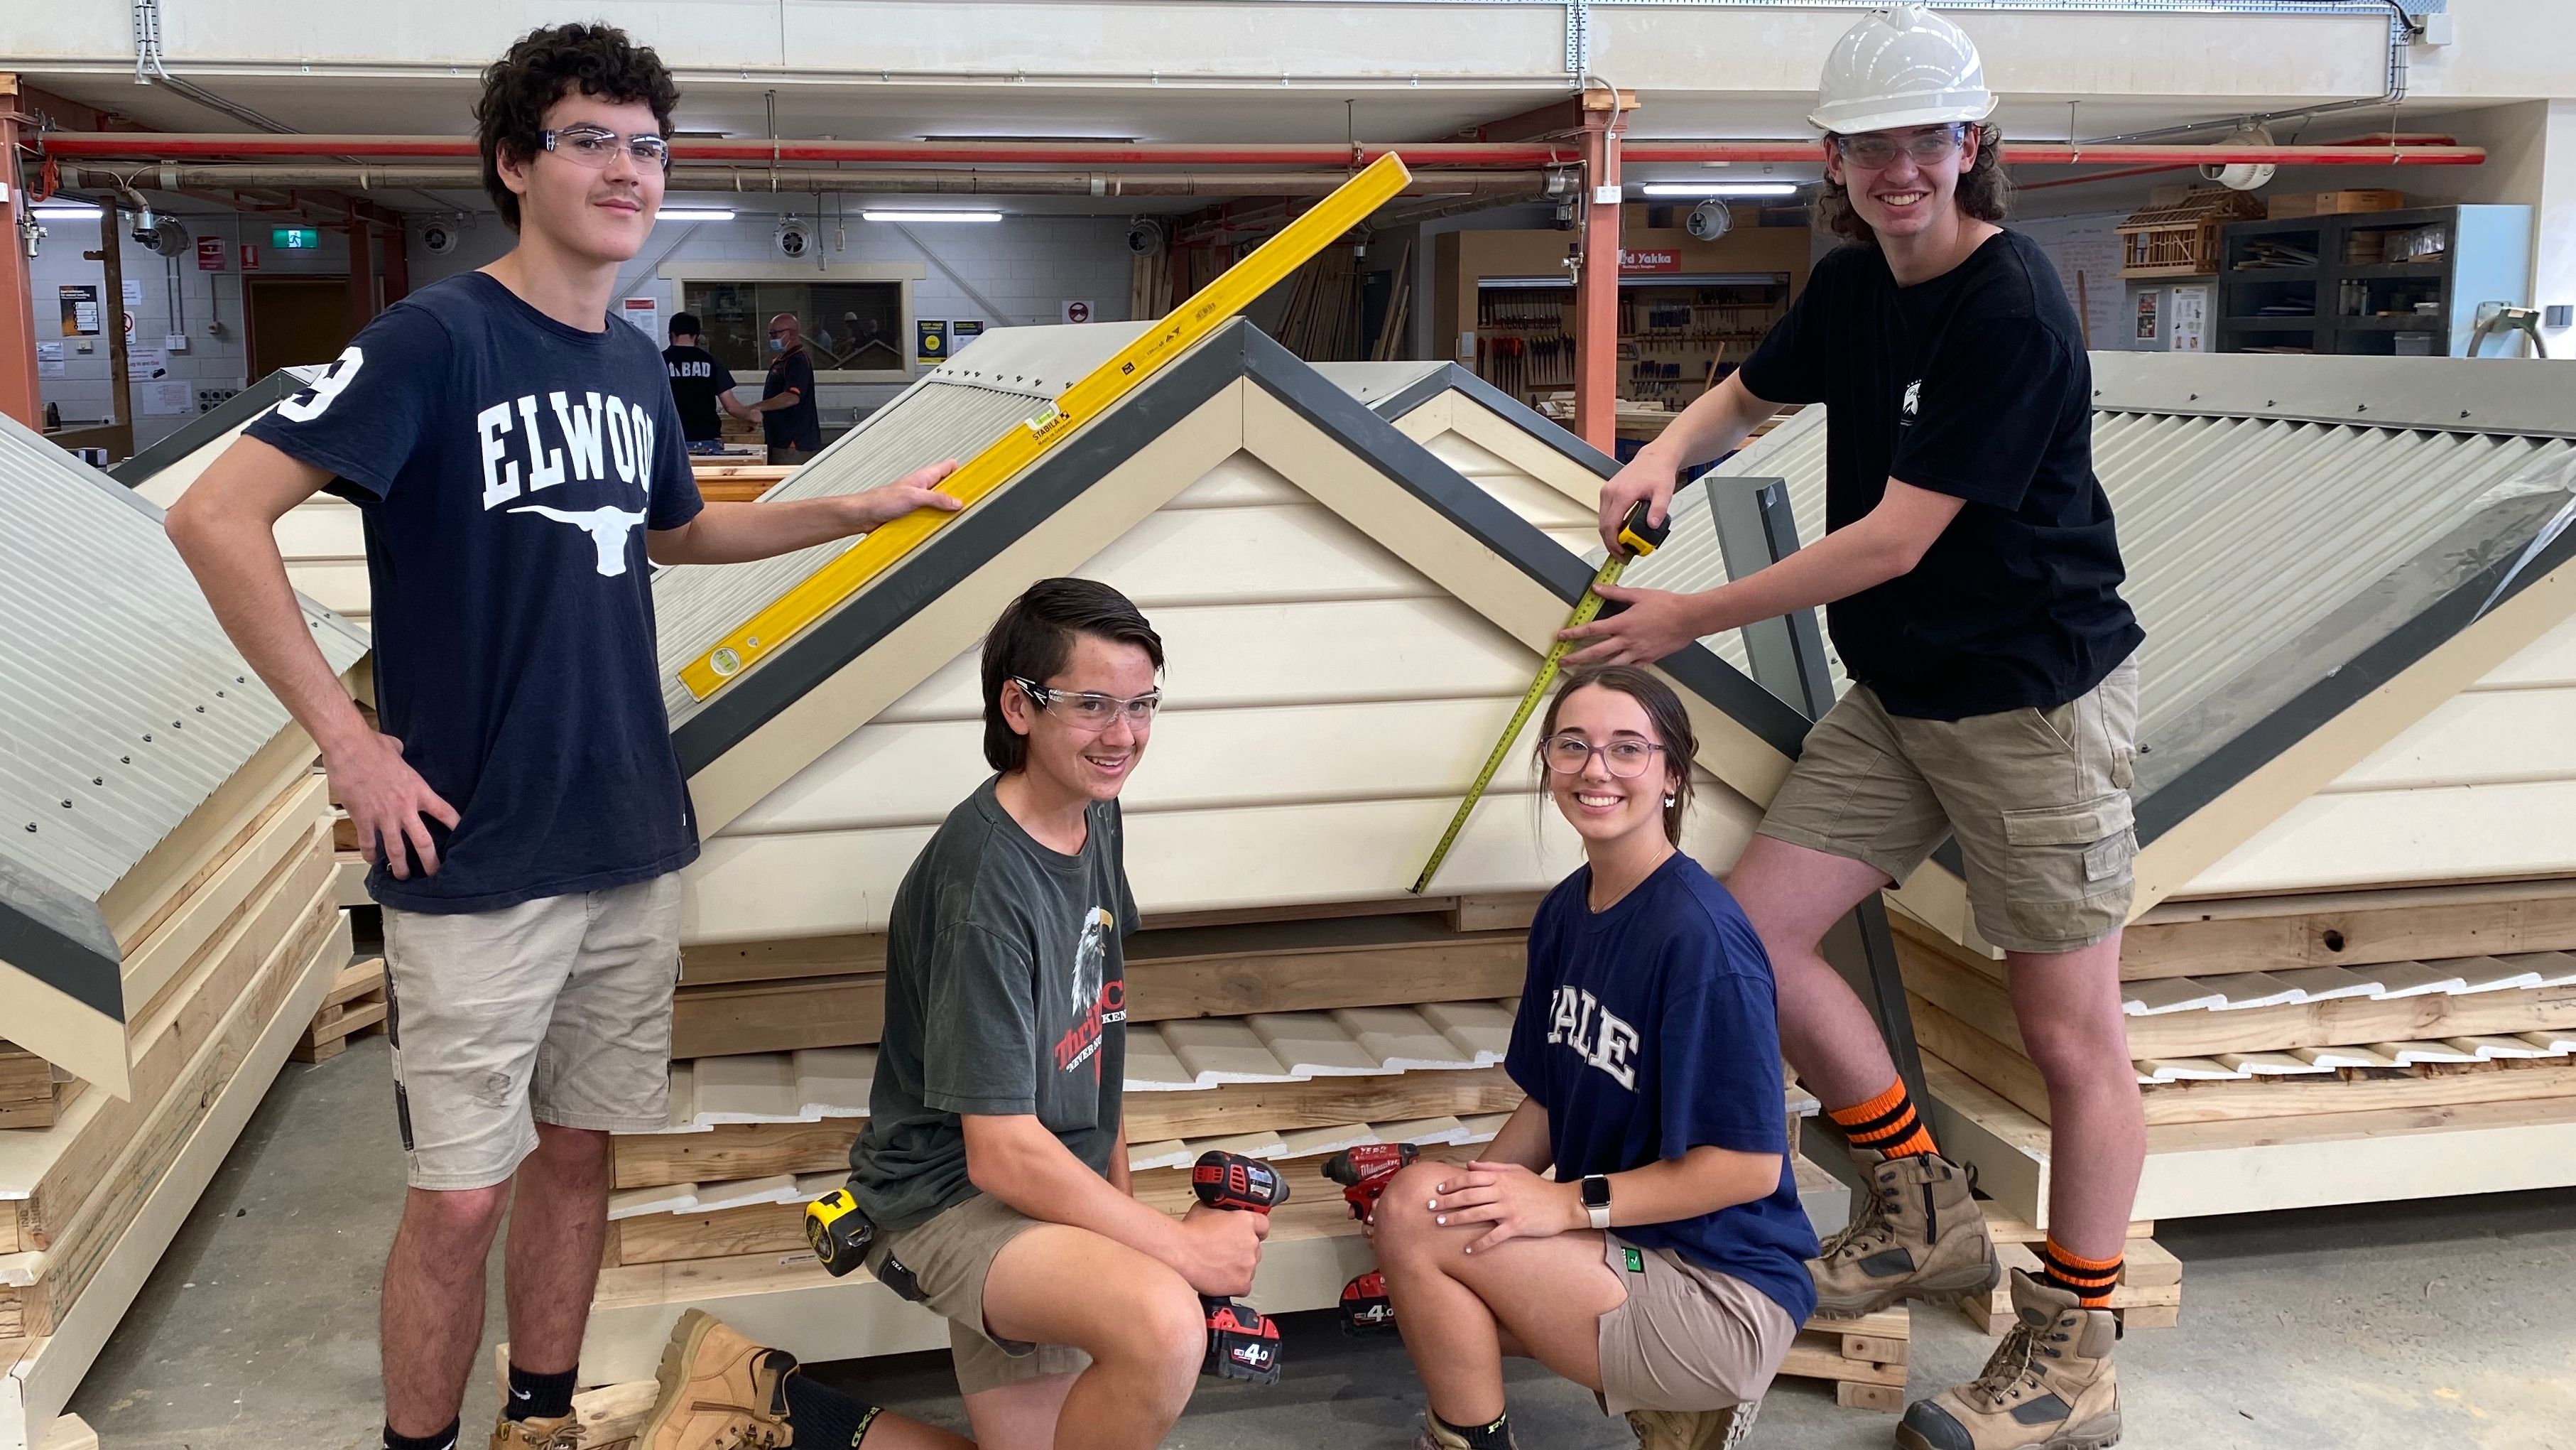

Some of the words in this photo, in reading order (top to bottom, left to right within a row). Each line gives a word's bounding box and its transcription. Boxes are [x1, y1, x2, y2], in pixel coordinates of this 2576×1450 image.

[1638, 253, 1670, 264] Yakka
[1033, 419, 1060, 440] STABILA
[1367, 1304, 1394, 1322] 4.0
[1244, 1343, 1268, 1365] 4.0
